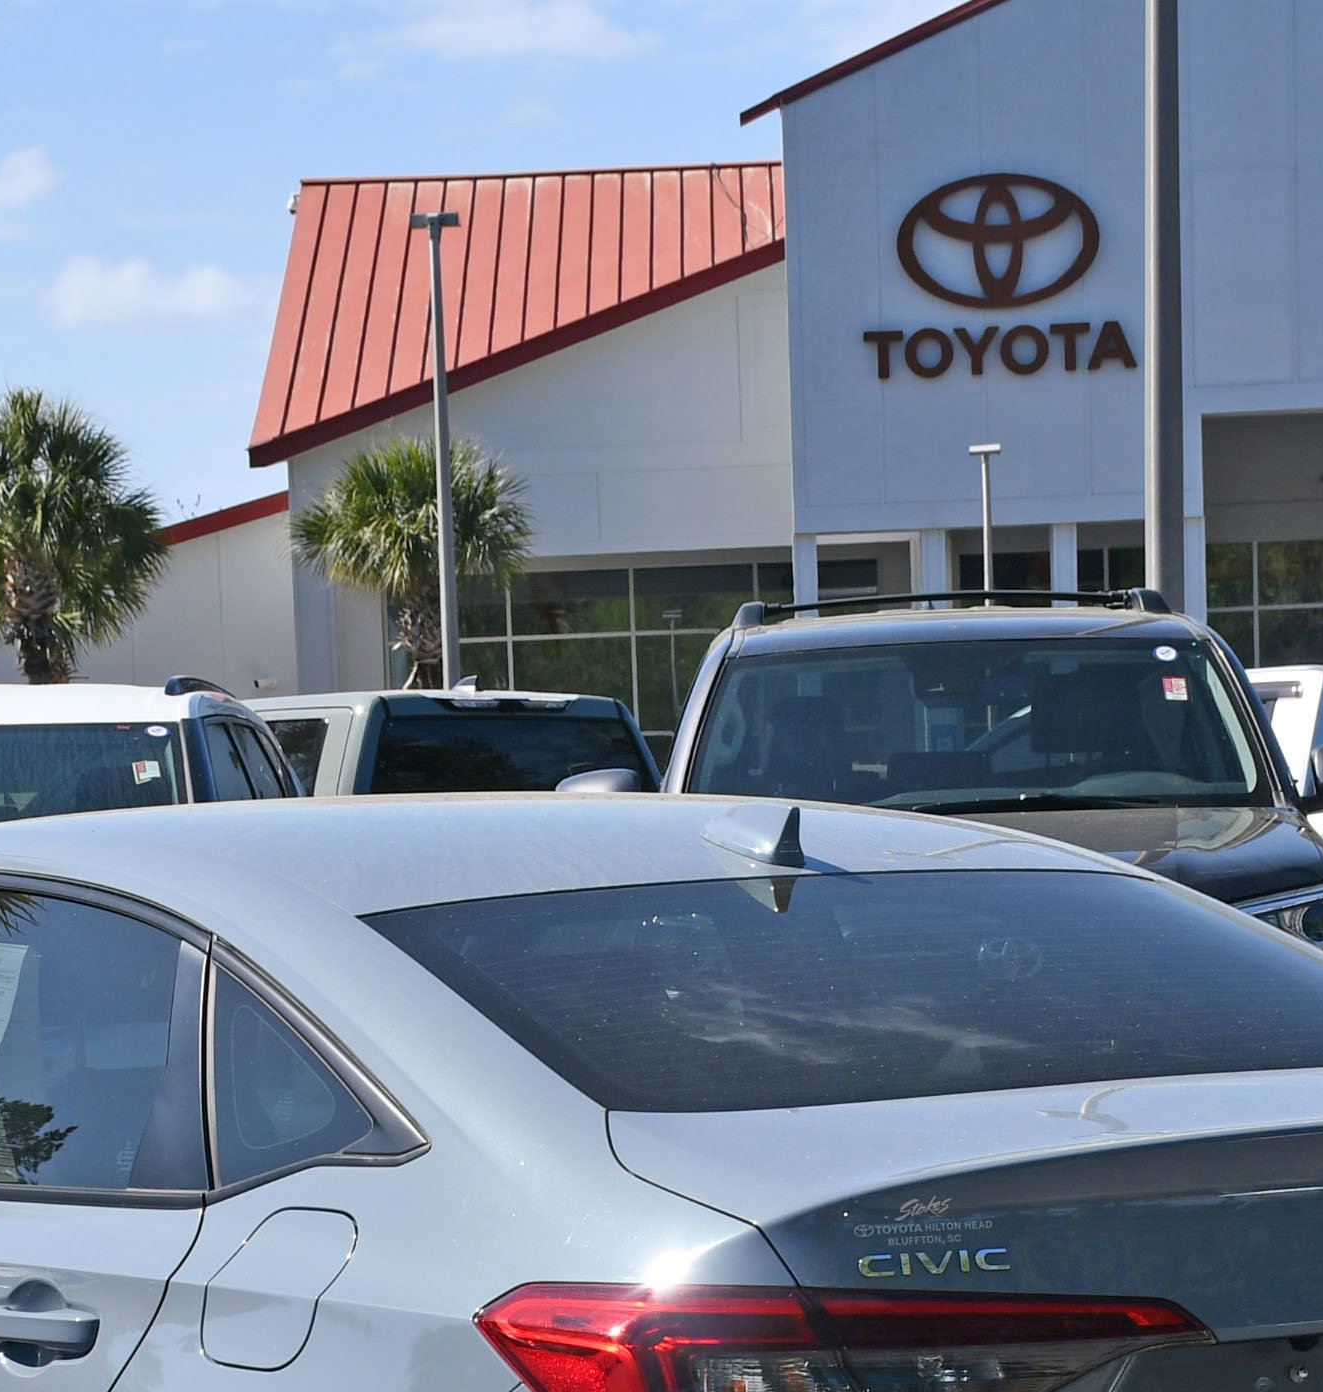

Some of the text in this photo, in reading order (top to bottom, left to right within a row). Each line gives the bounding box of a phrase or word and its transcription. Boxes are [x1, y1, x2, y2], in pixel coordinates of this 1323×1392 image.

[863, 321, 1137, 379] TOYOTA
[894, 1195, 953, 1221] Stokes
[875, 1219, 993, 1236] TOYOTA HILTON HEAD
[887, 1233, 963, 1247] BLUFFTON, SC
[858, 1247, 1011, 1278] CIVIC
